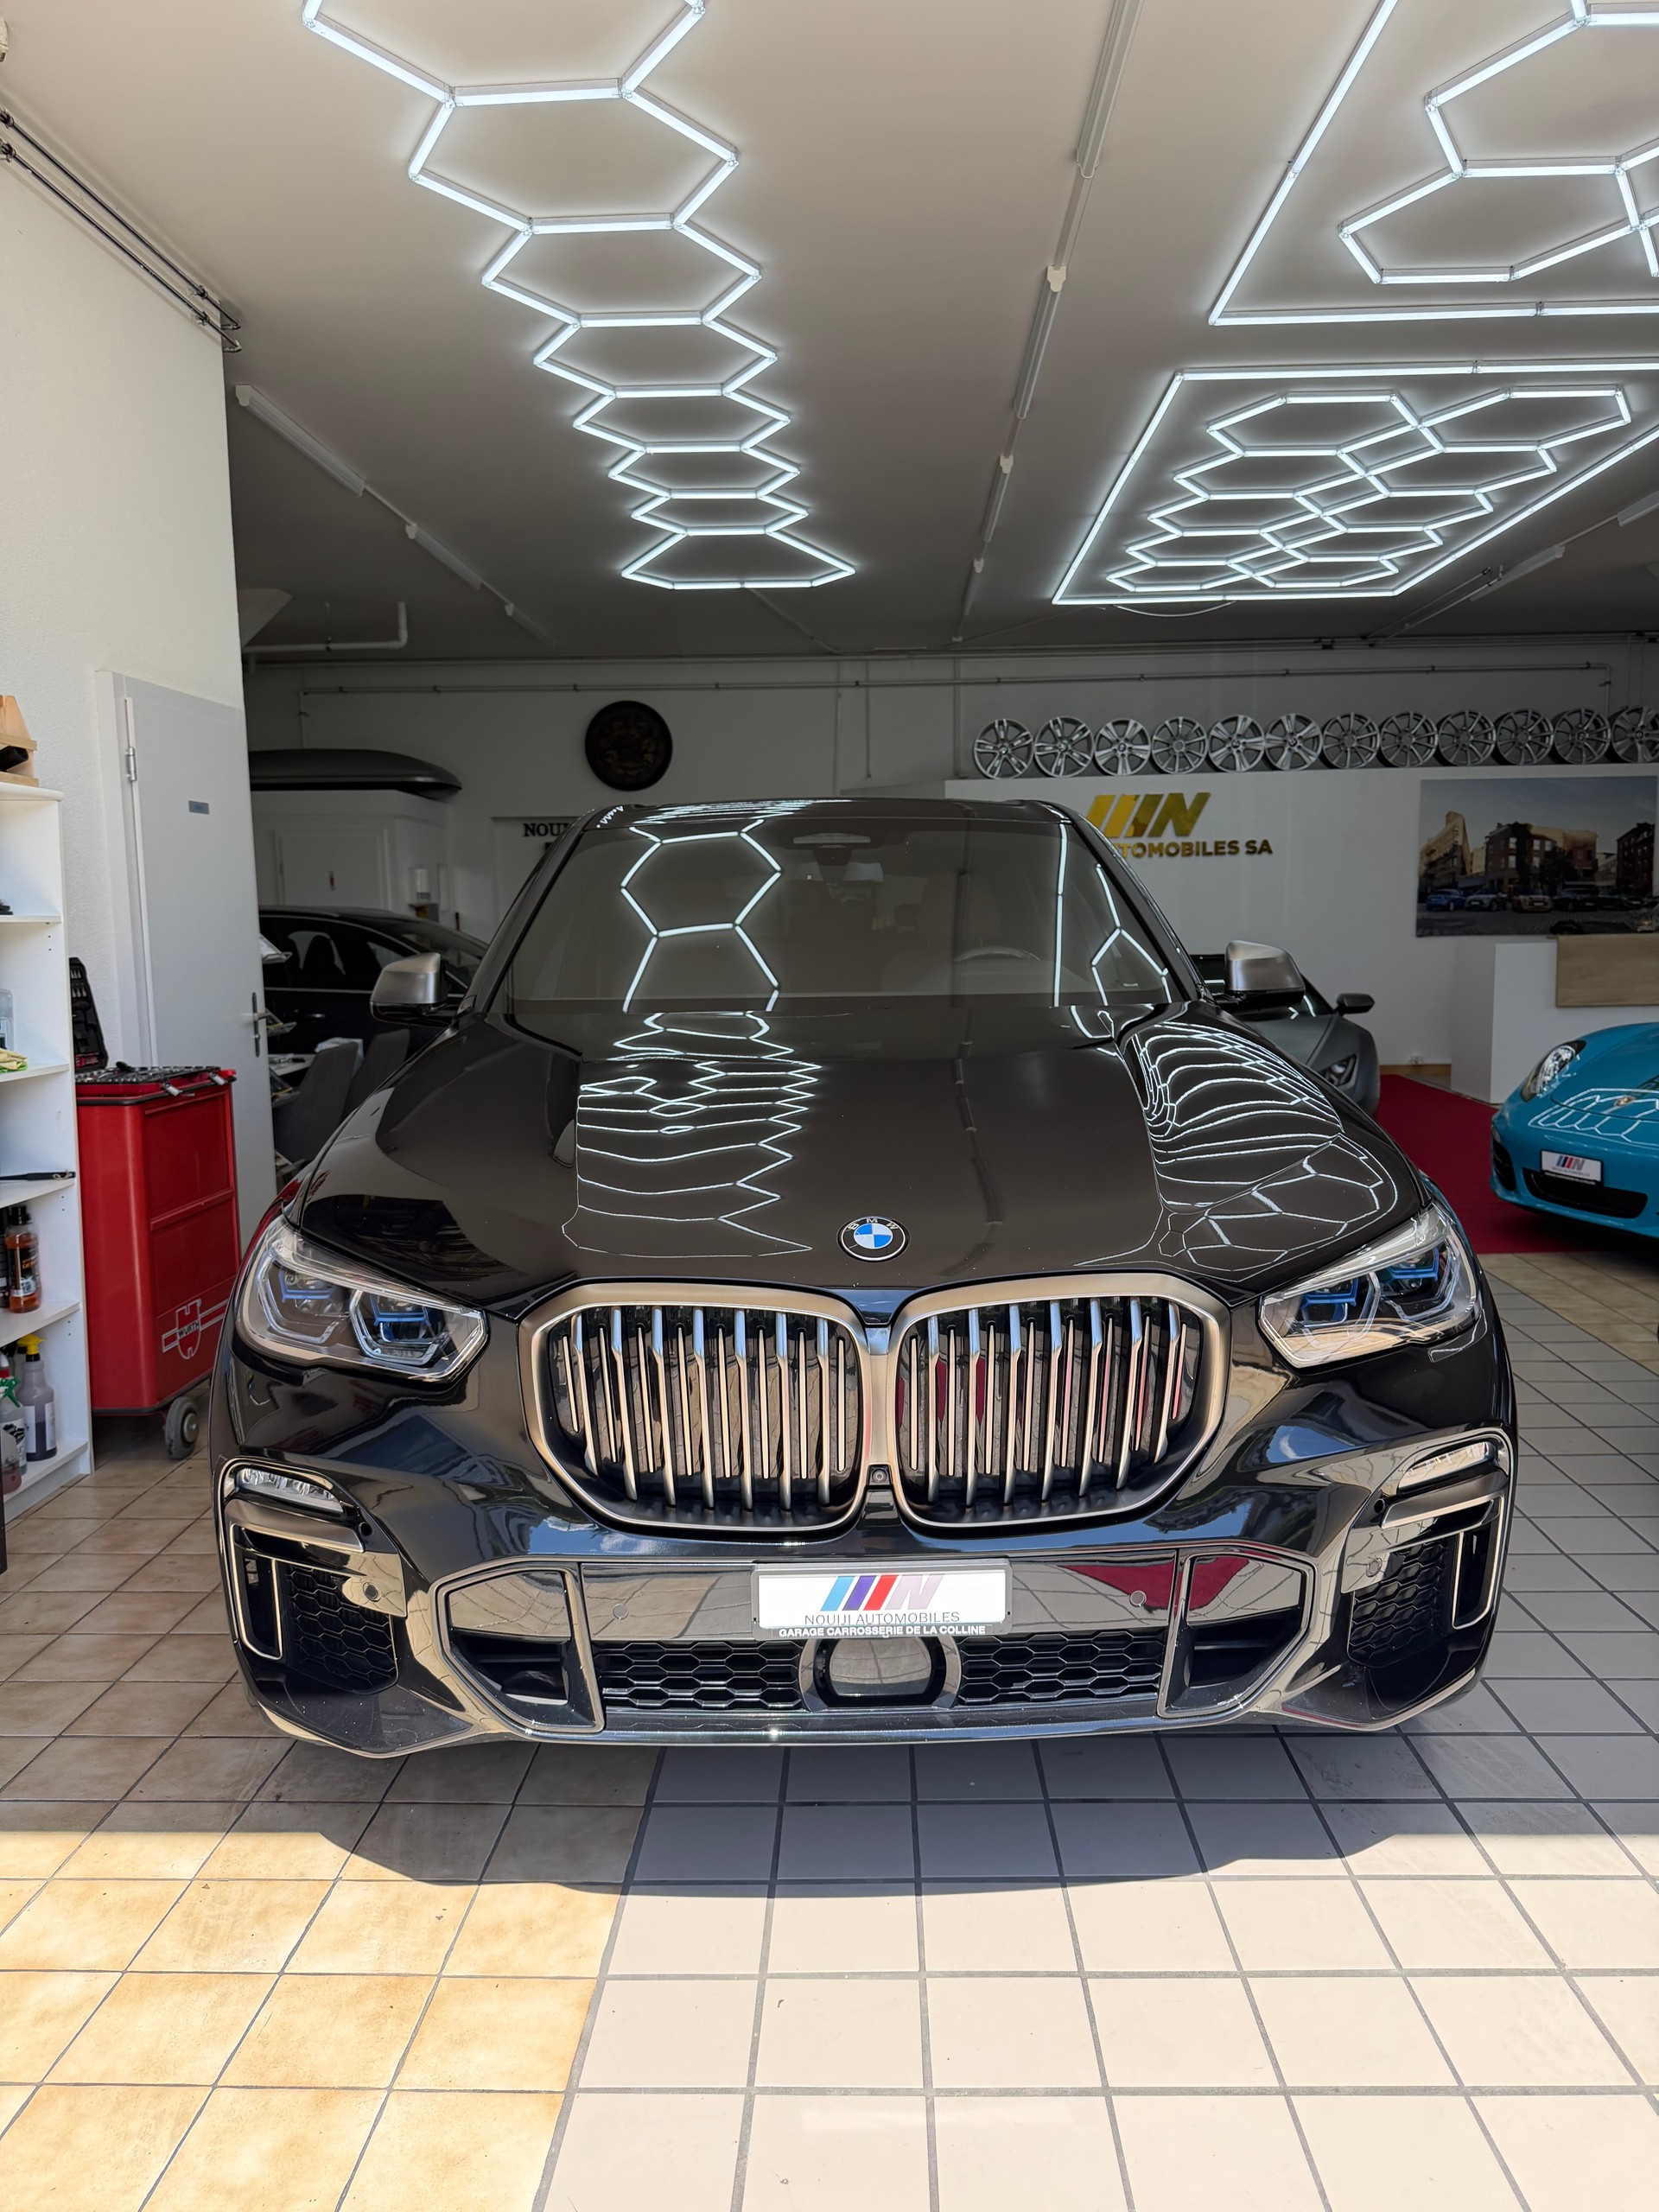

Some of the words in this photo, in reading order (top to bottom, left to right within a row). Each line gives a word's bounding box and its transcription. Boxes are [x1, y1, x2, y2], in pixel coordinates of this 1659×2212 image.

[1115, 840, 1240, 858] TOMOBILES
[1245, 838, 1273, 855] SA
[848, 1217, 899, 1230] BMW
[855, 1611, 960, 1626] AUTOMOBILES
[779, 1627, 824, 1637] GARAGE
[826, 1625, 904, 1637] CARROSSERIE
[906, 1625, 921, 1635] DE
[923, 1625, 938, 1635] LA
[938, 1624, 986, 1635] COLLINE
